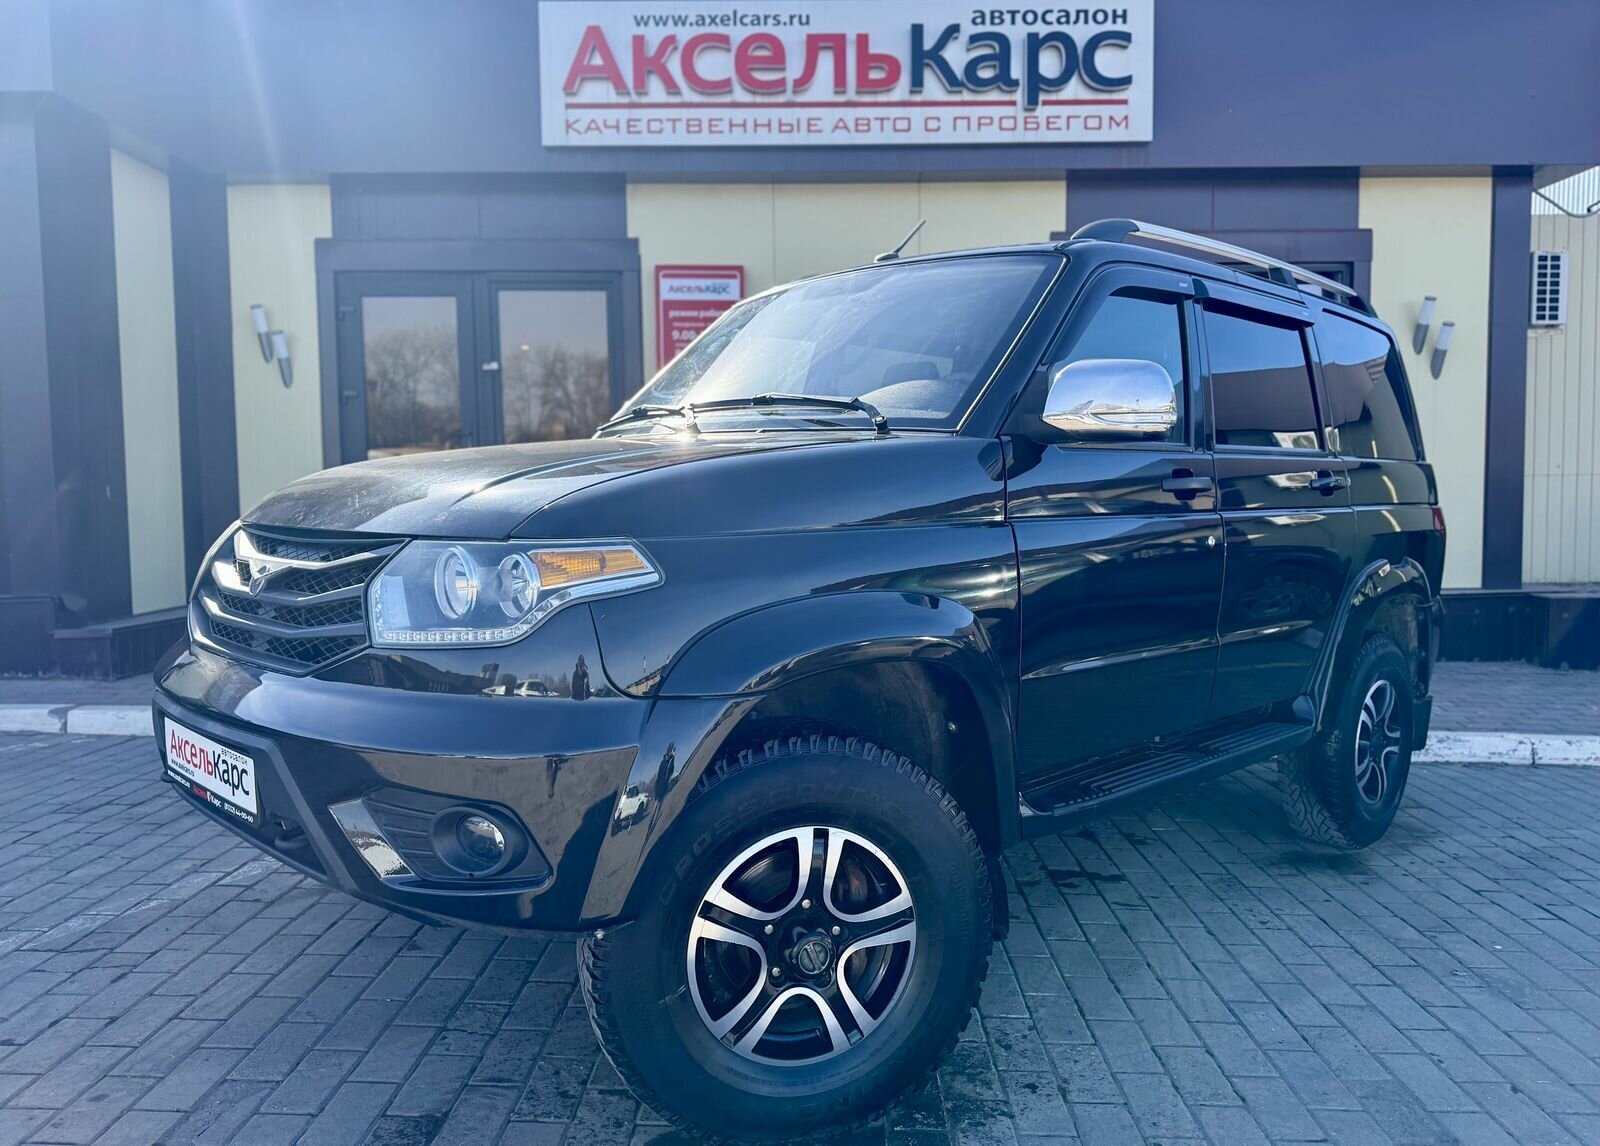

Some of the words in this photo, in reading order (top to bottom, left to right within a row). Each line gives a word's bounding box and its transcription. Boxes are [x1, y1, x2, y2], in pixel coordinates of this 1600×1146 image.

[632, 10, 811, 27] www.axelcars.ru
[971, 6, 1129, 26] автосалон
[563, 23, 1133, 109] АксельКарс
[565, 116, 823, 135] КАЧЕСТВЕННЫЕ
[831, 116, 912, 134] АВТО
[924, 116, 941, 133] С
[953, 114, 1129, 132] ПРОБЕГОМ
[170, 729, 250, 797] АксельКарс
